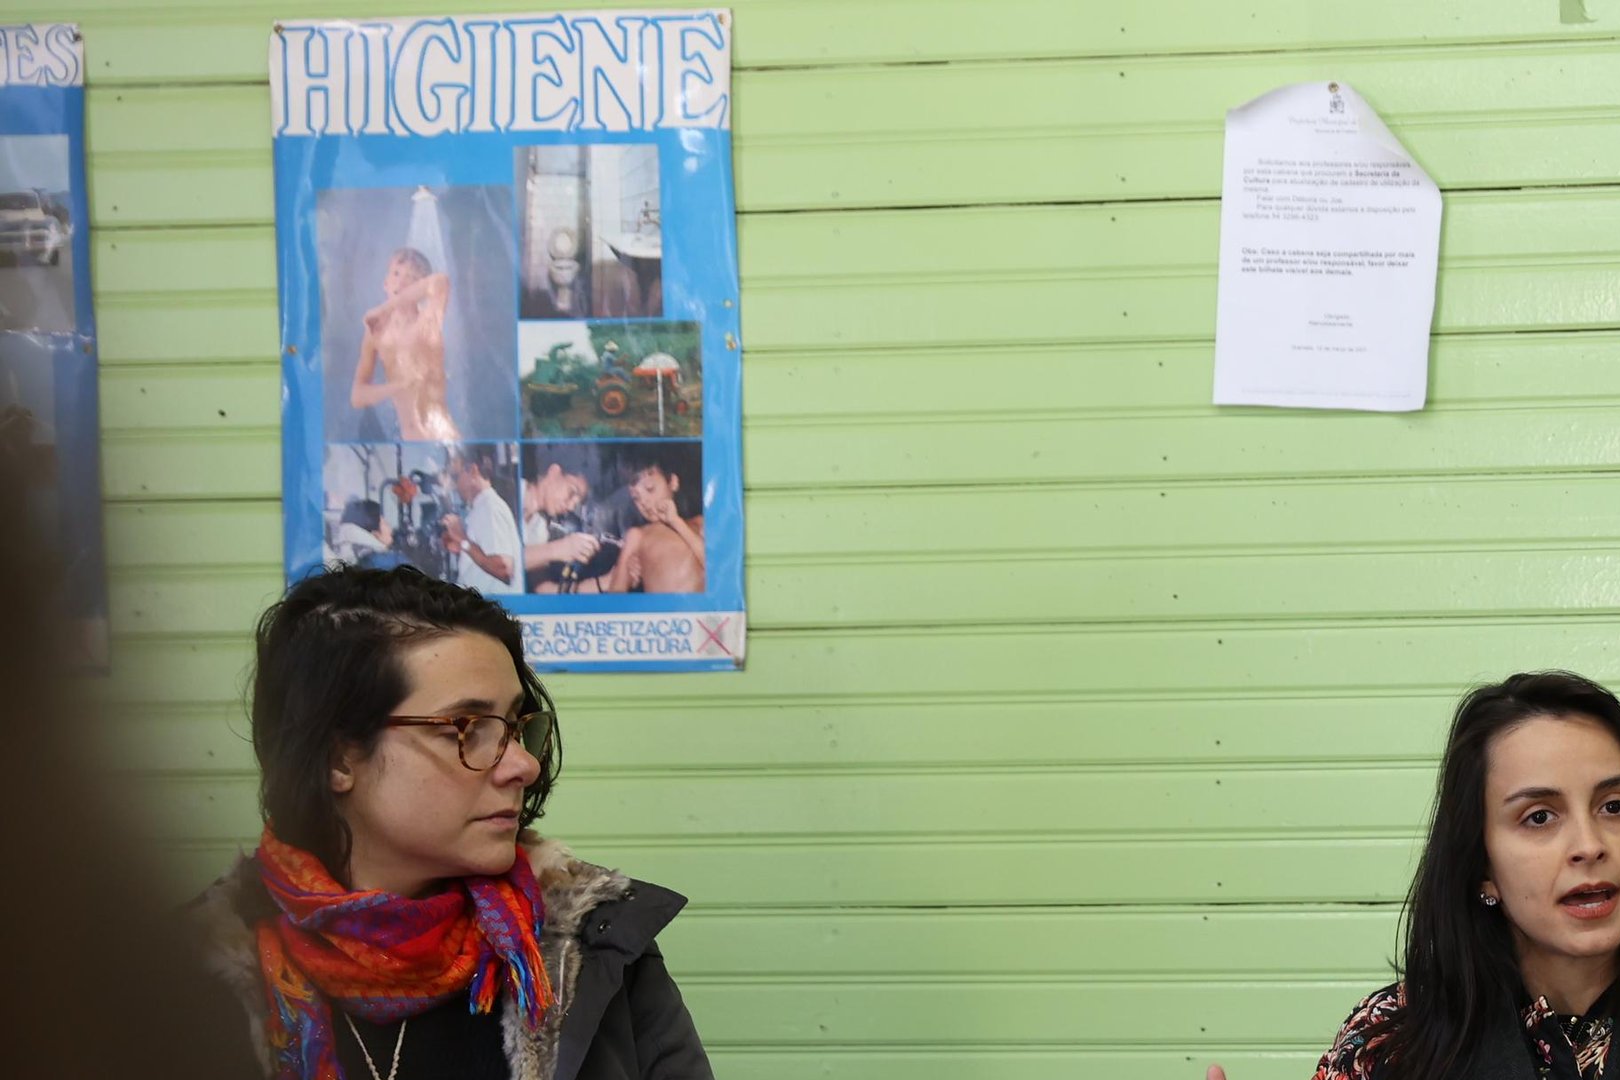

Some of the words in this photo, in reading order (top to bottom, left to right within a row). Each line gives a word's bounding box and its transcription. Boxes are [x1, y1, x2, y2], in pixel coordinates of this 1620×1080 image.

[0, 24, 79, 86] ES
[277, 14, 726, 137] HIGIENE
[521, 620, 544, 638] DE
[553, 618, 693, 640] ALFABETIZAÇÃO
[597, 638, 609, 653] E
[613, 637, 693, 655] CULTURA
